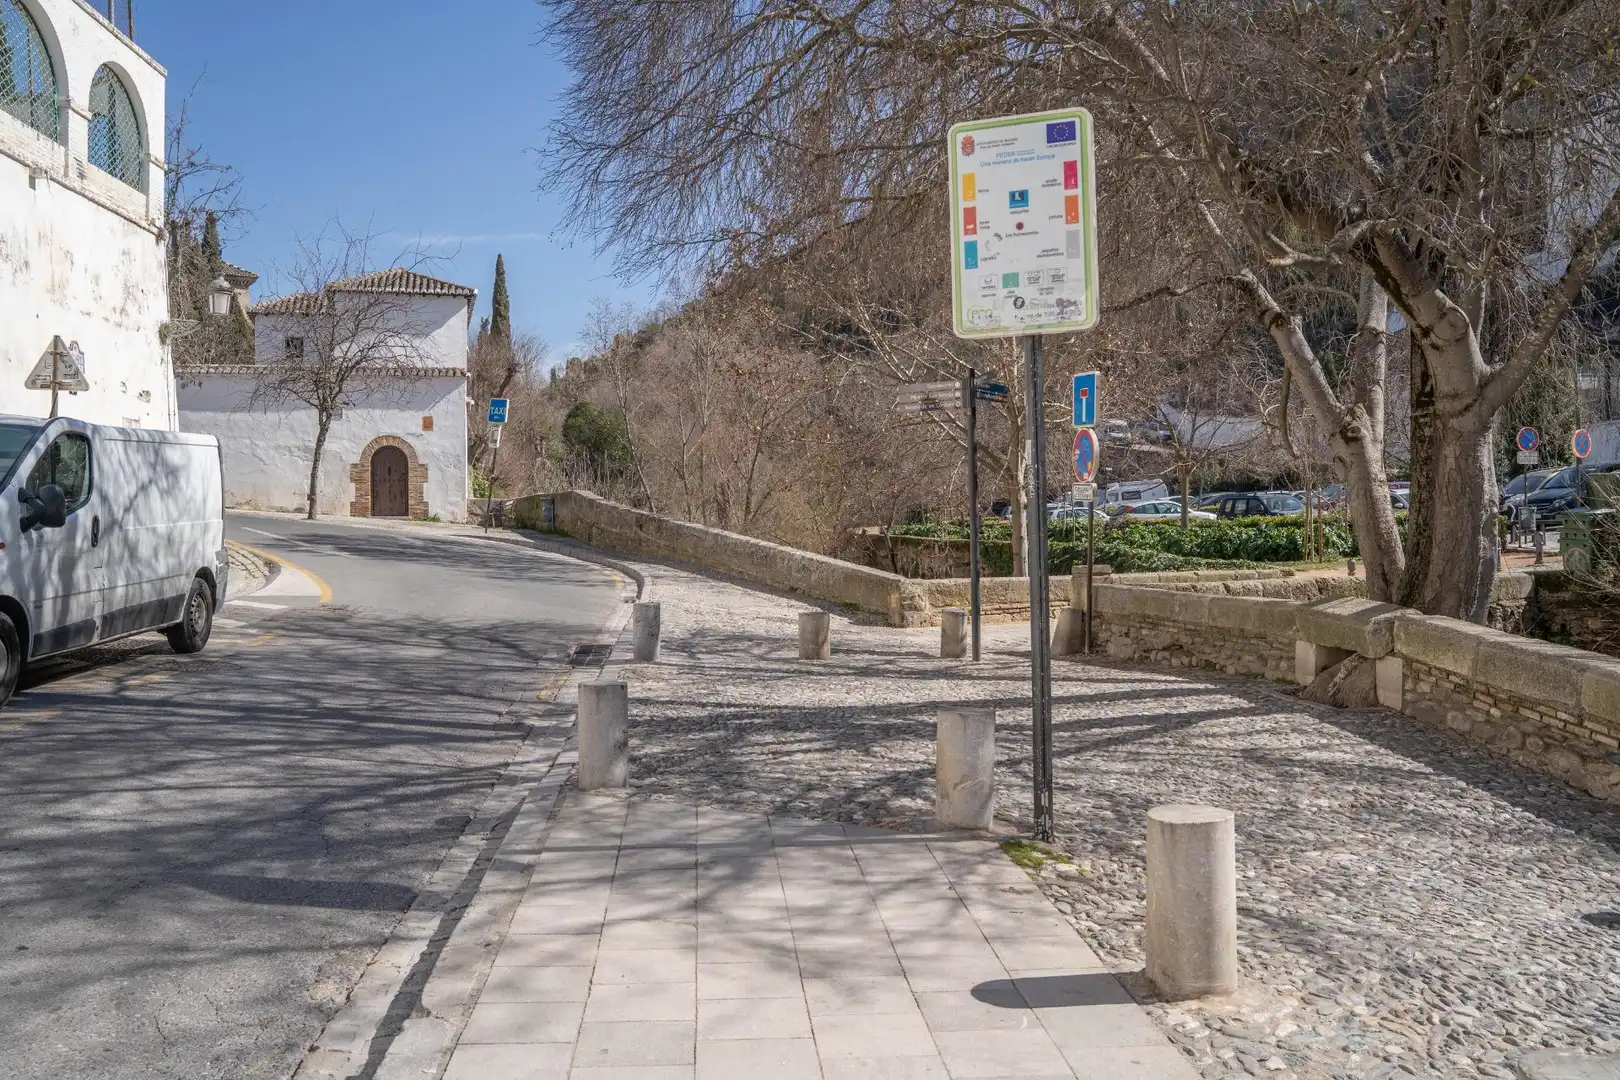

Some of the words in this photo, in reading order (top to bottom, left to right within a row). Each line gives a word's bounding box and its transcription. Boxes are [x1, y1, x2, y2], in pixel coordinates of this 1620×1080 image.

[995, 151, 1016, 159] FEDER
[1036, 153, 1056, 161] Europa
[490, 407, 507, 415] TAXI
